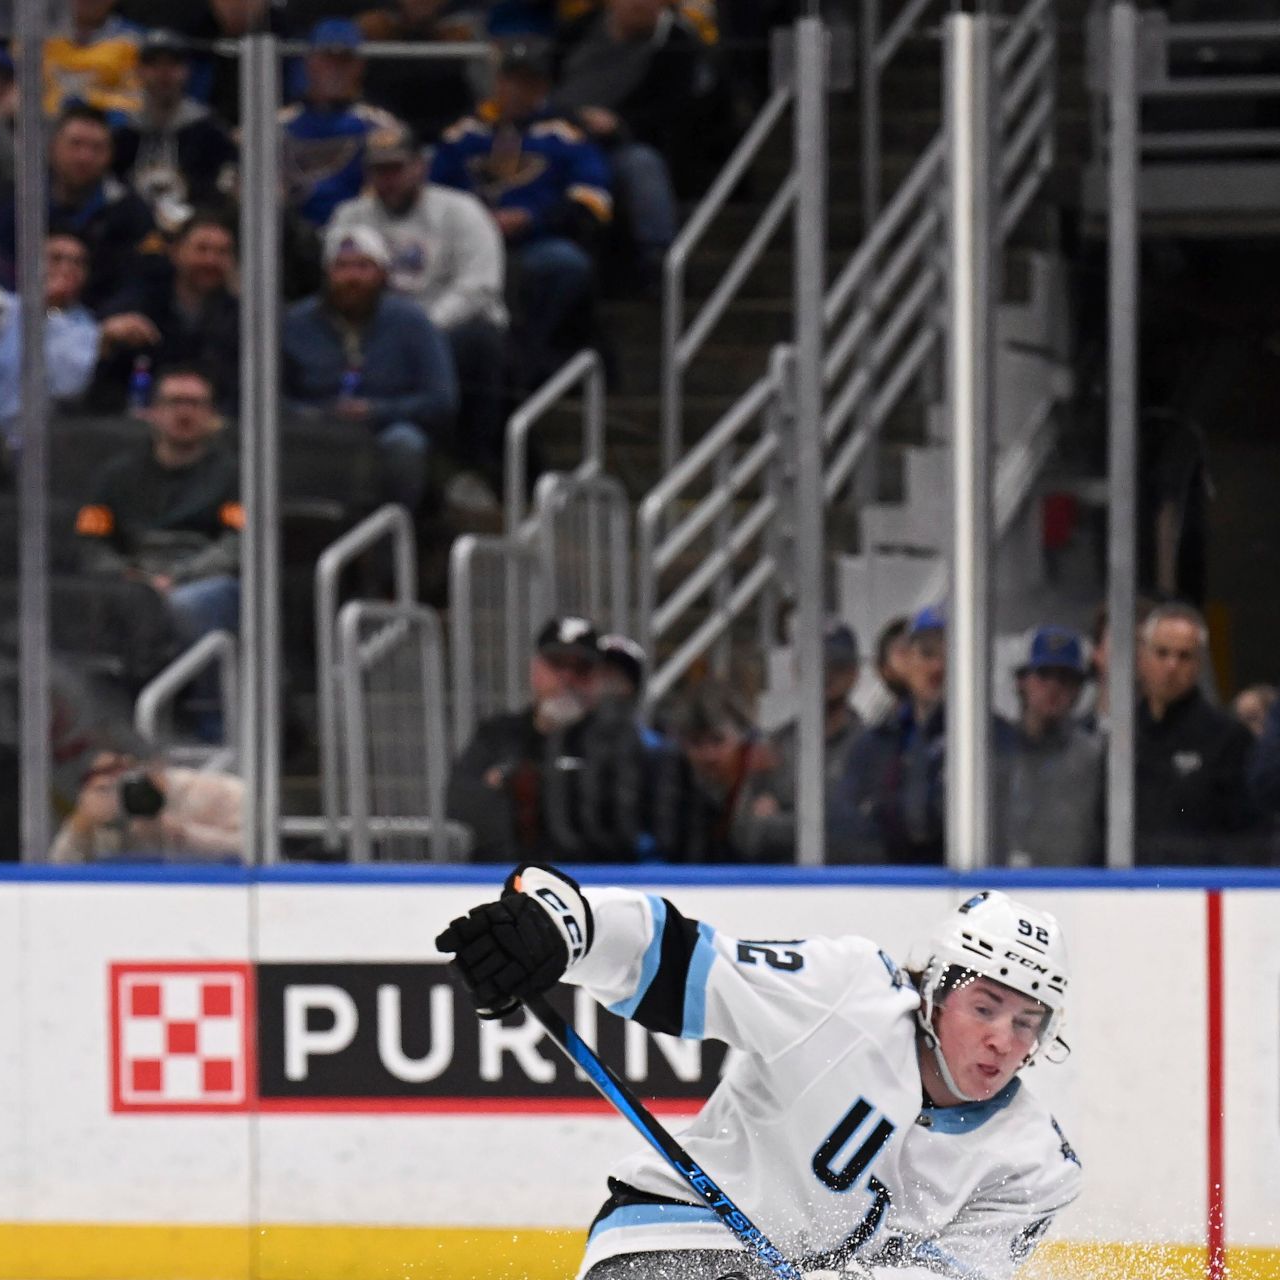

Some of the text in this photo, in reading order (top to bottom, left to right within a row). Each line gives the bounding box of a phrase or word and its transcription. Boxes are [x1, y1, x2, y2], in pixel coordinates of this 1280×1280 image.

[1017, 918, 1049, 946] 92
[1004, 950, 1048, 975] CCM
[281, 983, 730, 1083] PURIN
